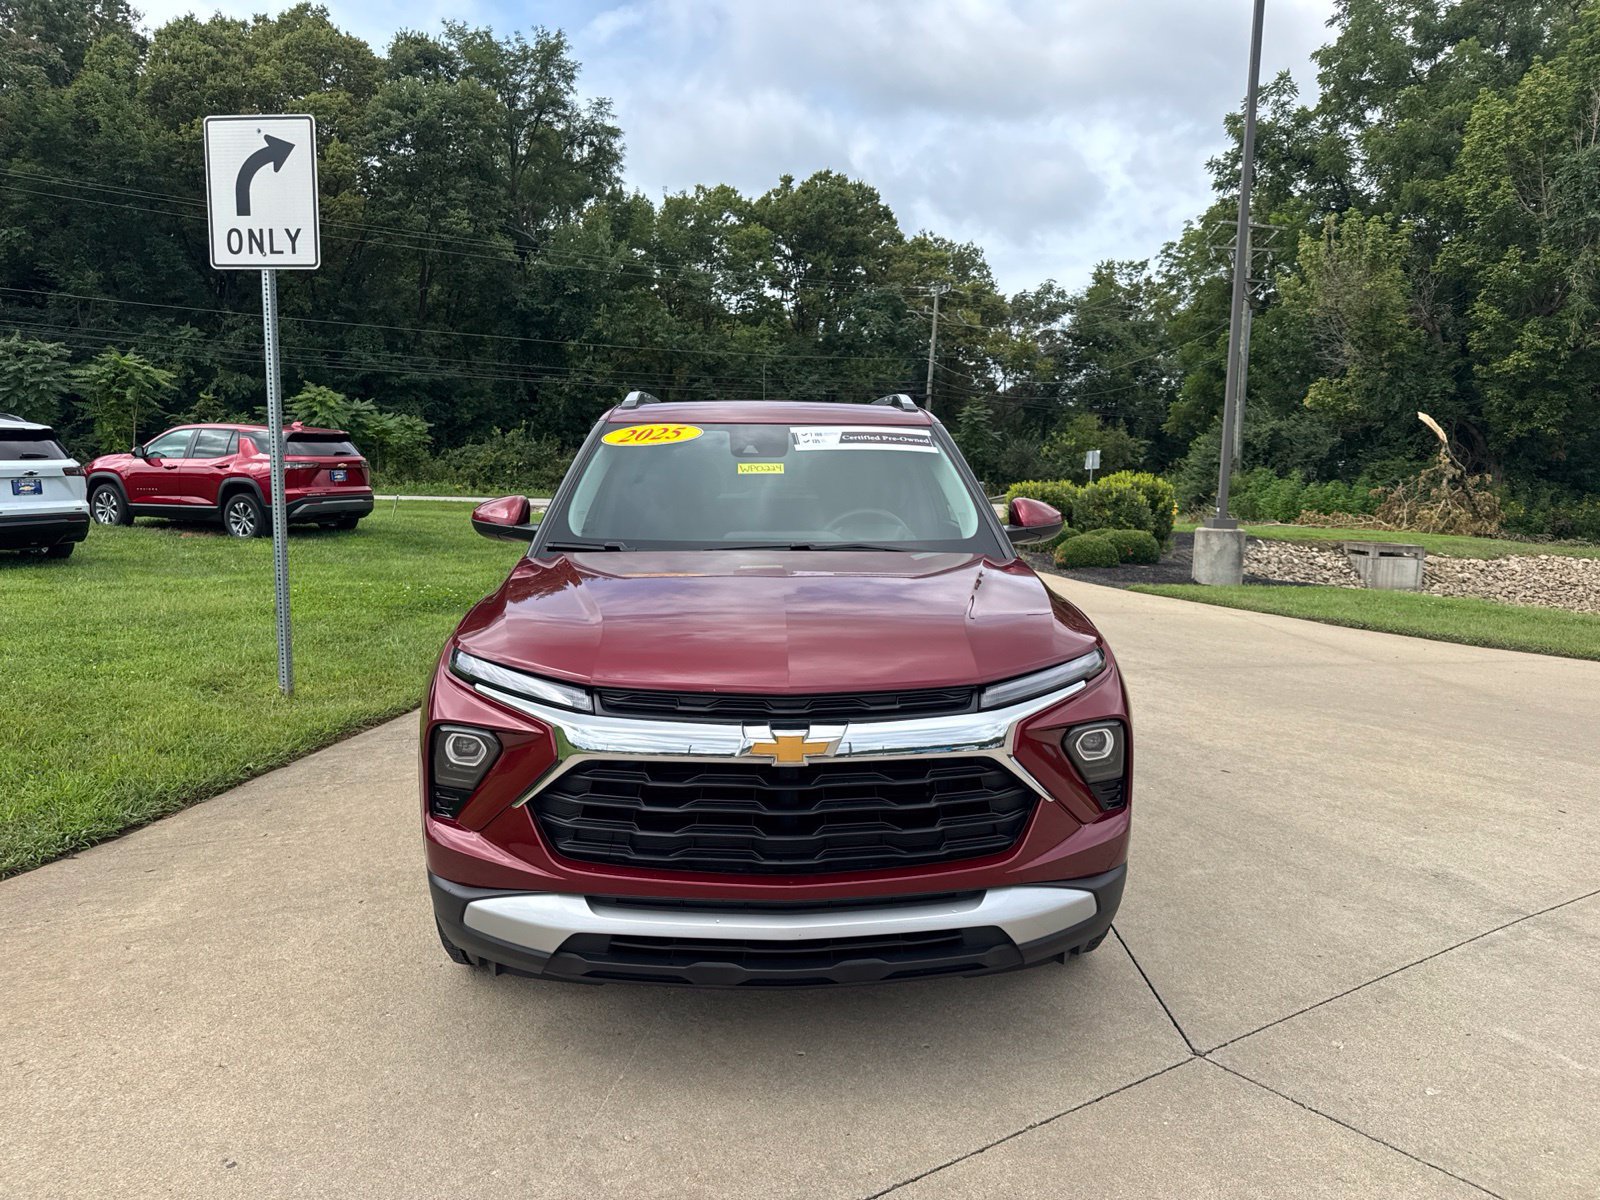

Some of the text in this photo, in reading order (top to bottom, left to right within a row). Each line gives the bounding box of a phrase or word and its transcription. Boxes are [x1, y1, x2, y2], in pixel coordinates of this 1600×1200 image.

[227, 228, 302, 255] ONLY
[618, 427, 688, 443] 2025
[842, 434, 881, 442] Certified
[882, 435, 930, 444] Pre-Owned
